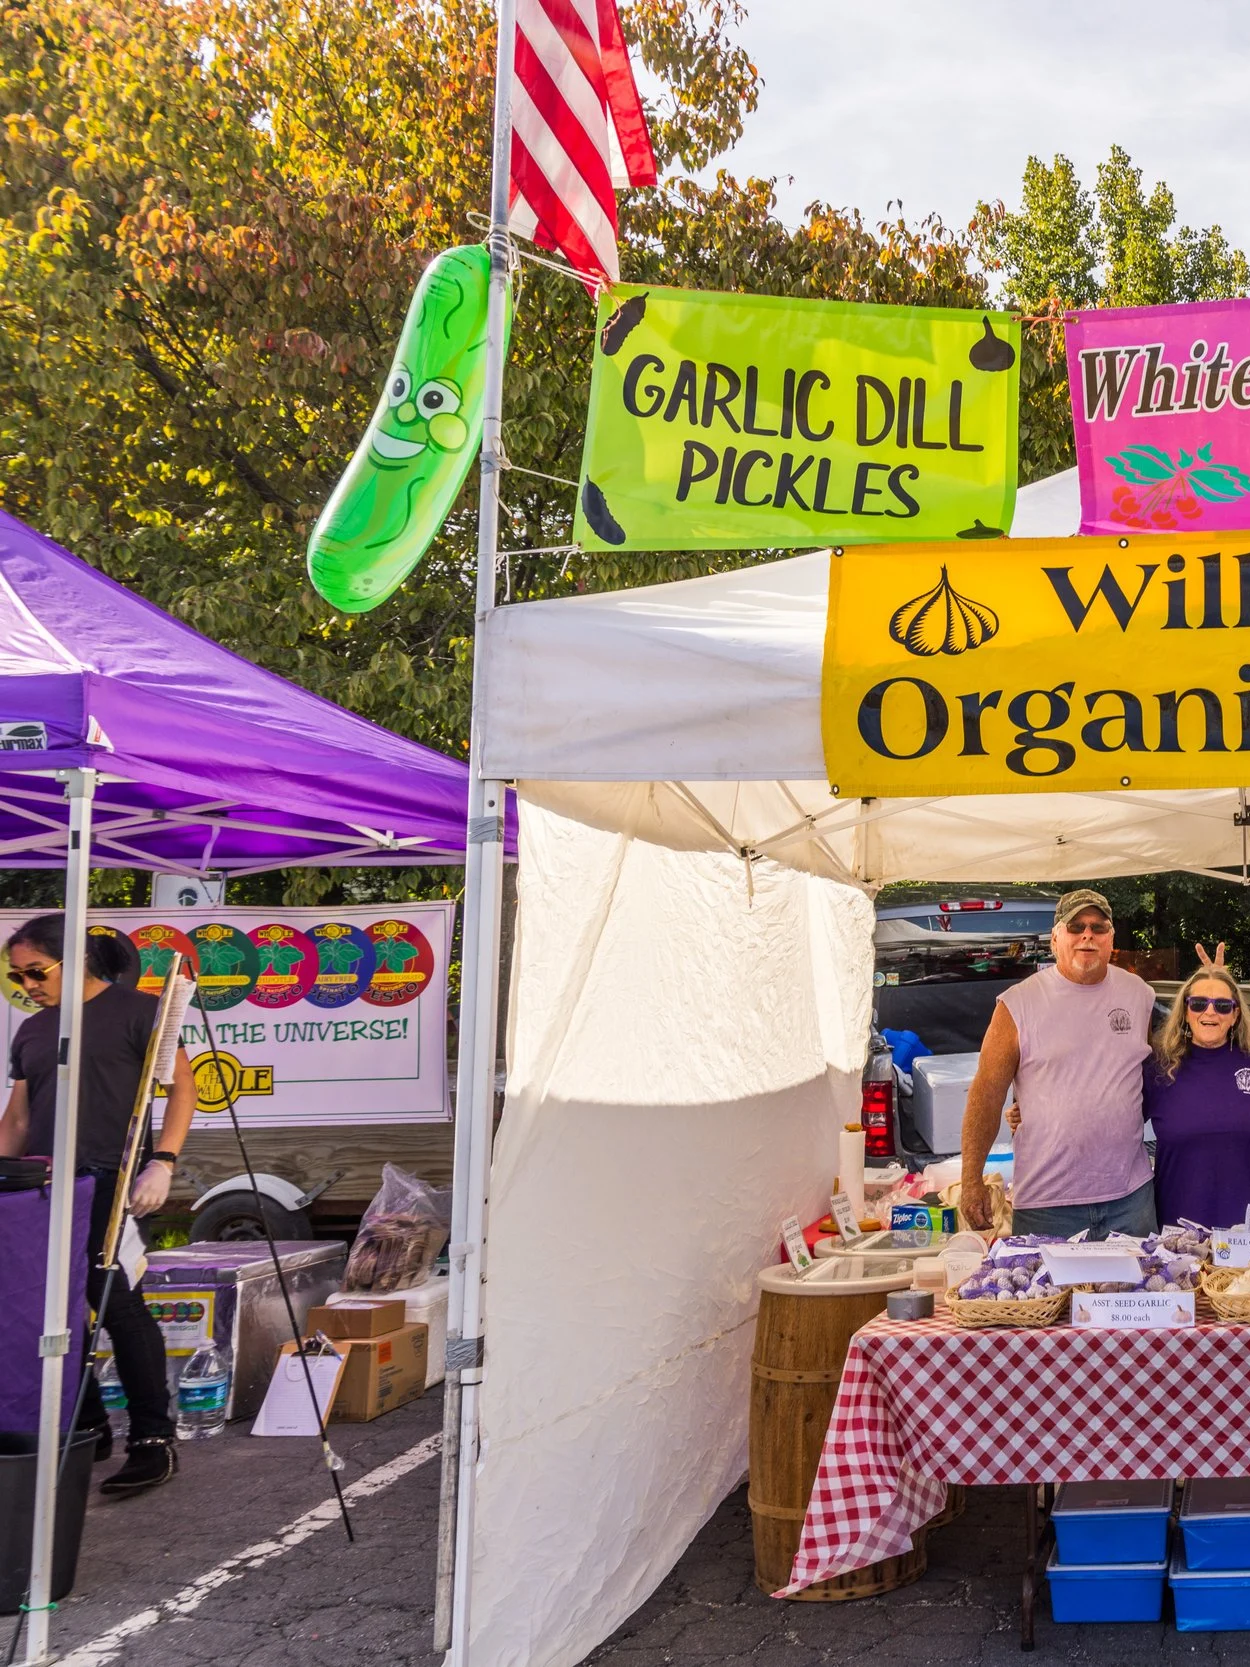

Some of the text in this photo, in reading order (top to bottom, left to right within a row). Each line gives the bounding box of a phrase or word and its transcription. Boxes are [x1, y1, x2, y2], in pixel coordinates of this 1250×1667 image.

[623, 353, 985, 453] GARLIC DILL
[675, 439, 920, 519] PICKLES
[181, 1018, 409, 1045] IN THE UNIVERSE!
[893, 1213, 913, 1226] Ziploc
[1227, 1238, 1248, 1247] REAL
[1091, 1298, 1171, 1308] ASST. SEED GARLIC
[1111, 1313, 1150, 1323] $8.00 each
